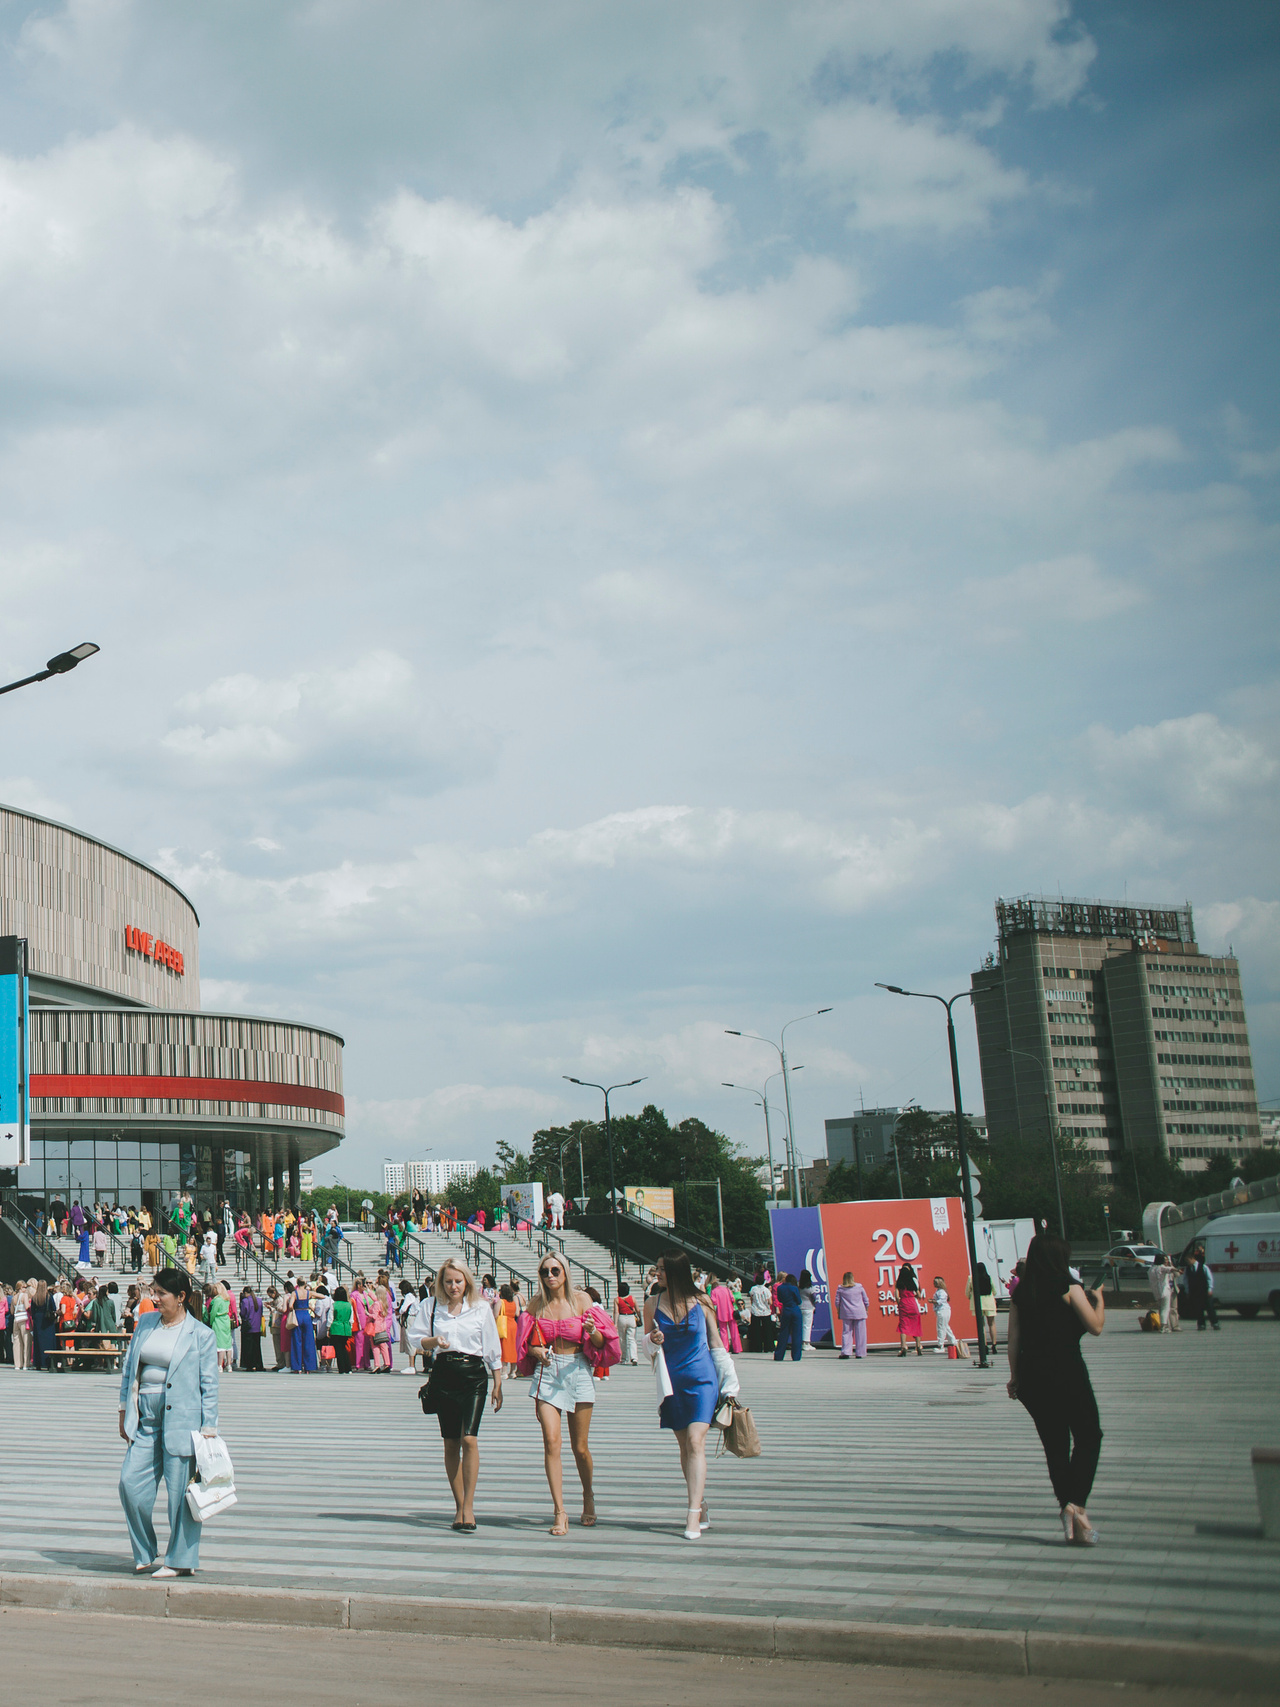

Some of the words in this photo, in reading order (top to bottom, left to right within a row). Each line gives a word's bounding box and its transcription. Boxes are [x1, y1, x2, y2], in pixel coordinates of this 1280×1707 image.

[125, 924, 154, 957] LIVE
[154, 939, 185, 976] АРЕНА
[933, 1206, 946, 1215] 20
[871, 1227, 920, 1262] 20
